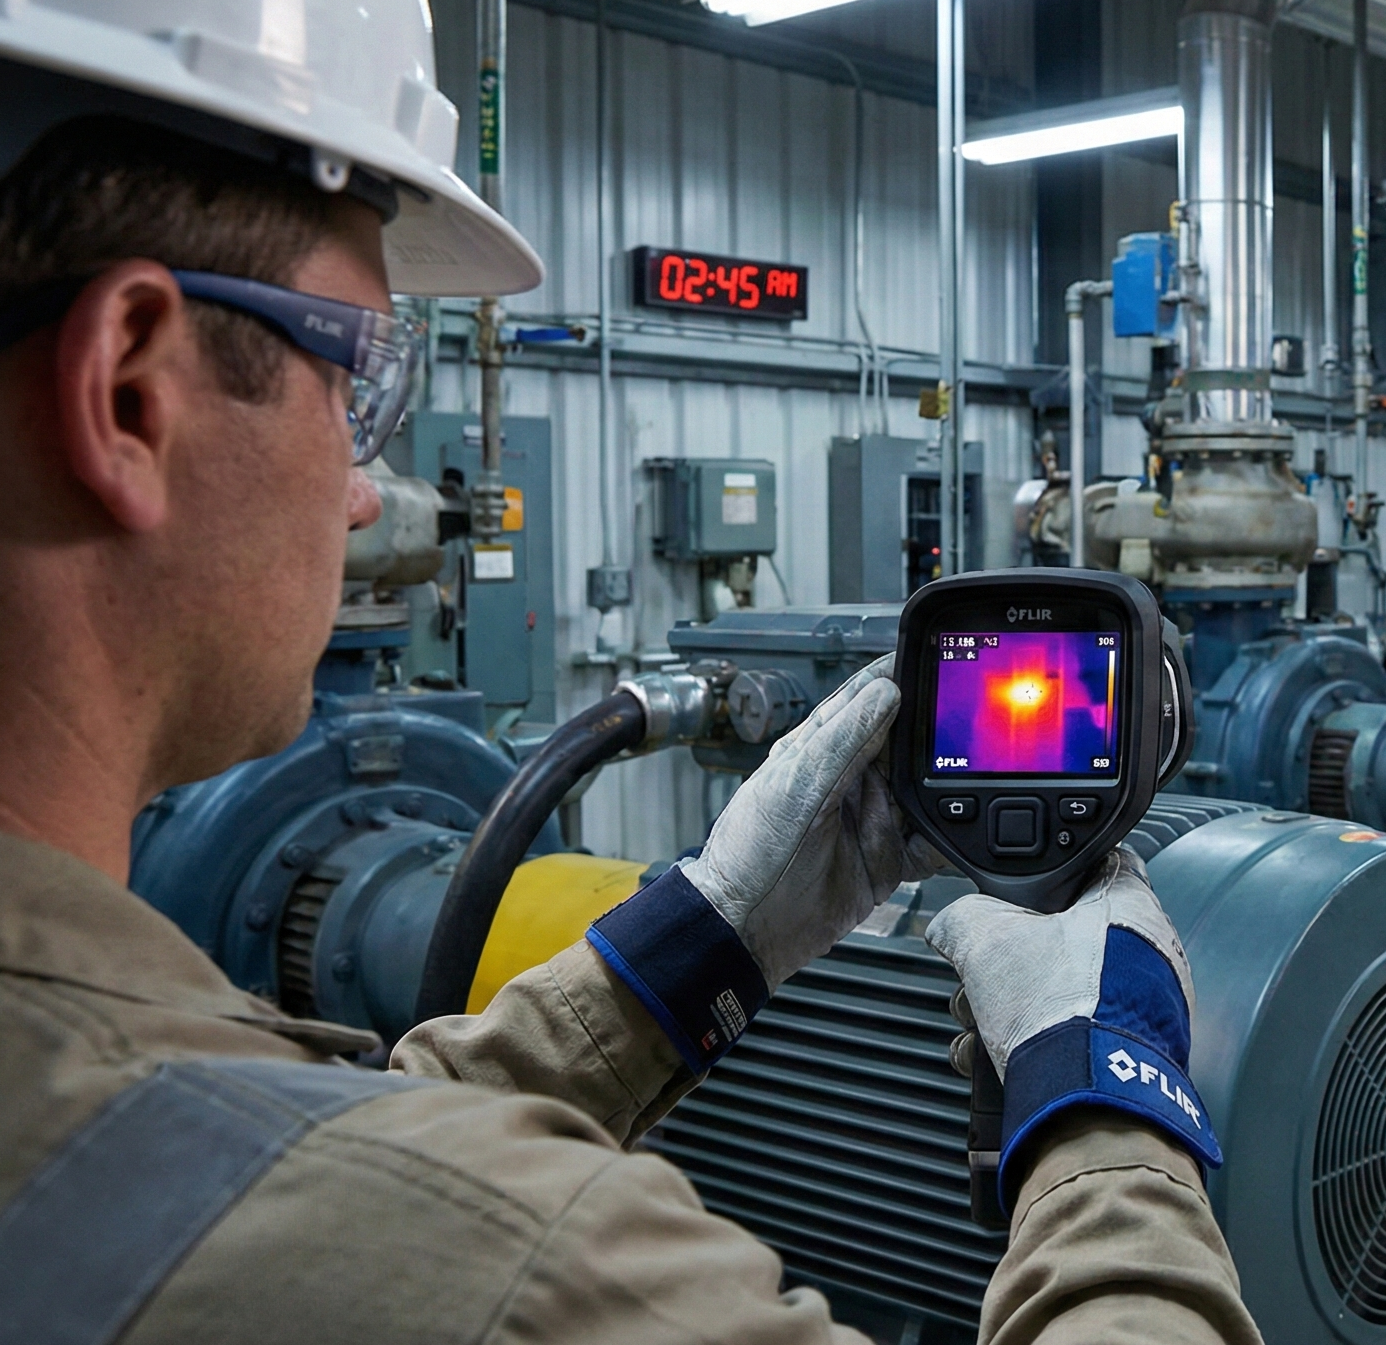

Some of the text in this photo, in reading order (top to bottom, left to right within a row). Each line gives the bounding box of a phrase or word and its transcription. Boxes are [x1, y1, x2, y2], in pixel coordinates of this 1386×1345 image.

[660, 255, 798, 309] 02:45 AM
[1019, 609, 1052, 621] FLIR
[1140, 1061, 1202, 1130] FLIR
